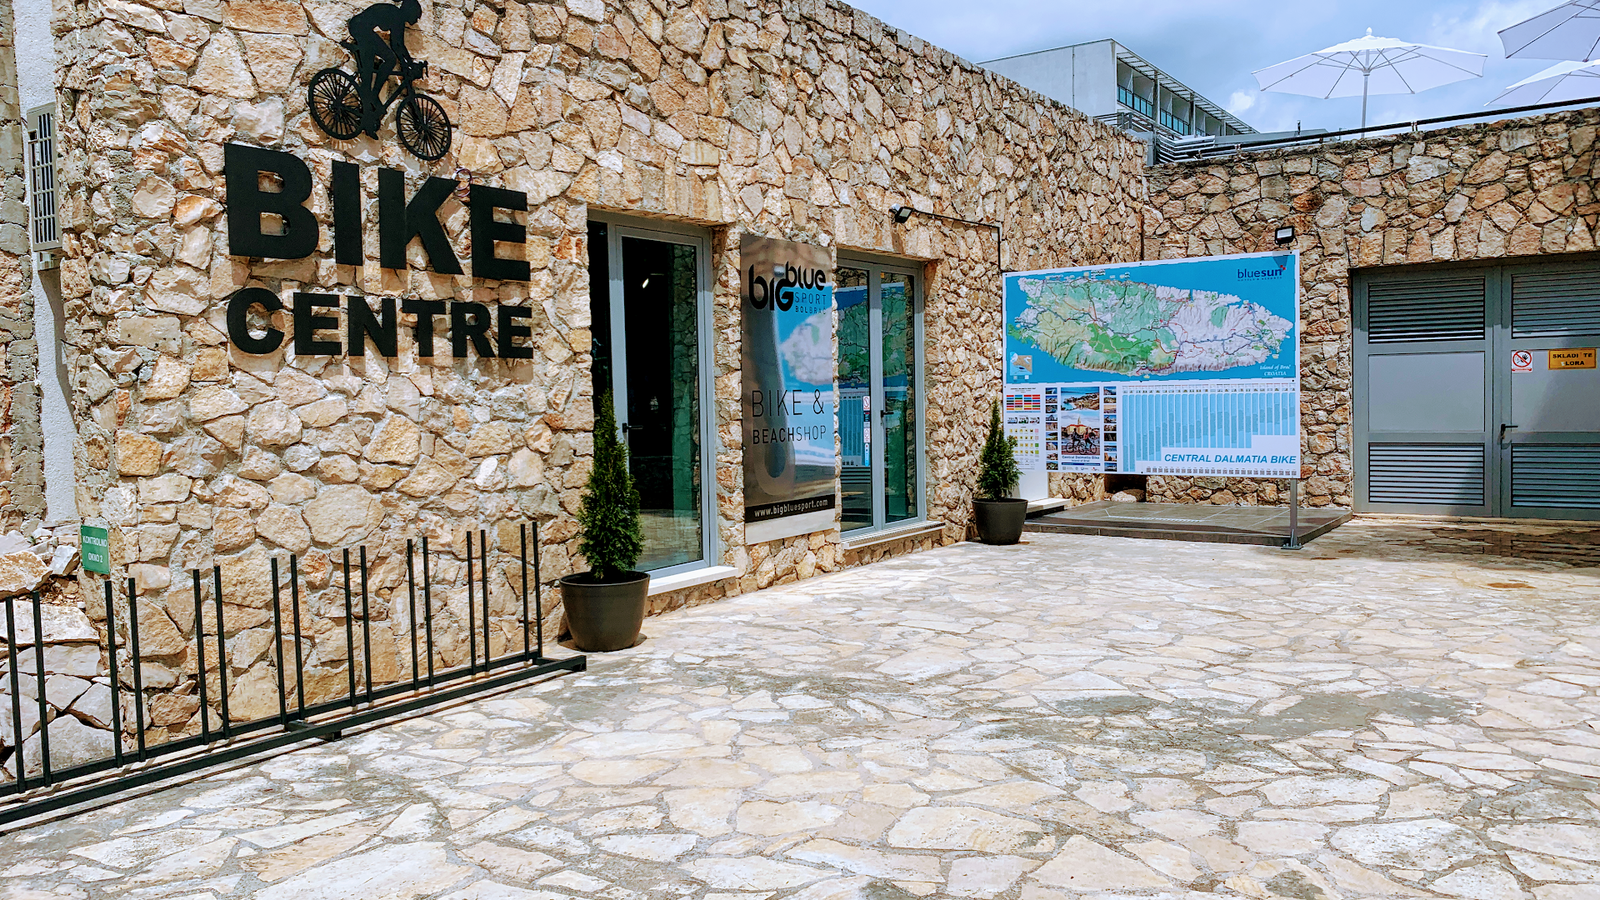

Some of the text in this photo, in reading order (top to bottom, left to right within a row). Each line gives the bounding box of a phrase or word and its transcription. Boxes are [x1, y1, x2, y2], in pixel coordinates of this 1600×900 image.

[224, 143, 531, 282] BIKE
[785, 261, 826, 291] blue
[1237, 268, 1282, 279] bluesun
[794, 292, 827, 305] SPORT
[226, 287, 534, 359] CENTRE
[752, 389, 825, 417] BIKE &
[1164, 454, 1297, 464] CENTRAL DALMATIA BIKE
[754, 499, 828, 517] www.bigbluesport.com
